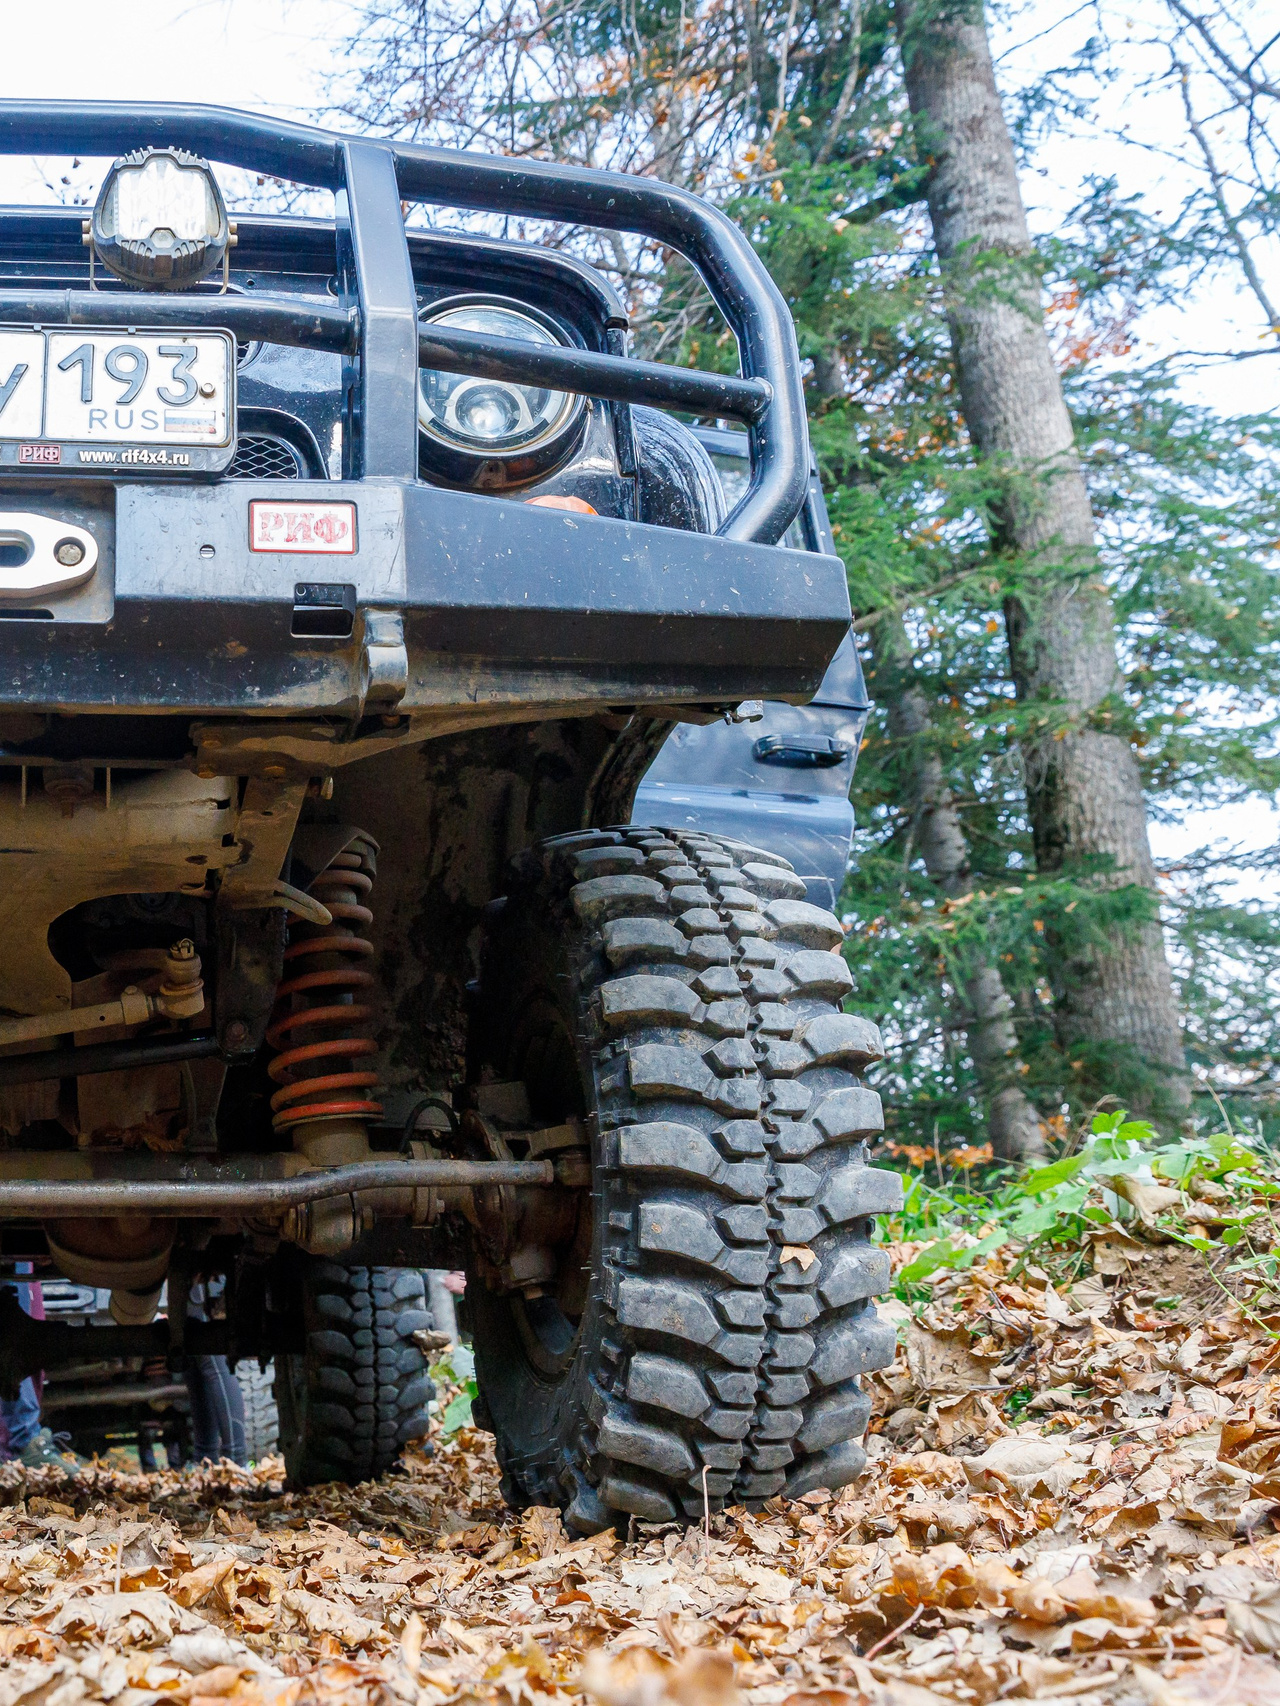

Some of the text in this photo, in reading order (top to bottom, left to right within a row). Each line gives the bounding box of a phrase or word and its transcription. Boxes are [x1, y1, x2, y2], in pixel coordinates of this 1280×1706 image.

[57, 344, 199, 407] 193
[88, 408, 159, 430] RUS
[20, 446, 60, 462] РИФ
[79, 449, 189, 466] www.rif4x4.ru
[257, 511, 349, 544] РИФ
